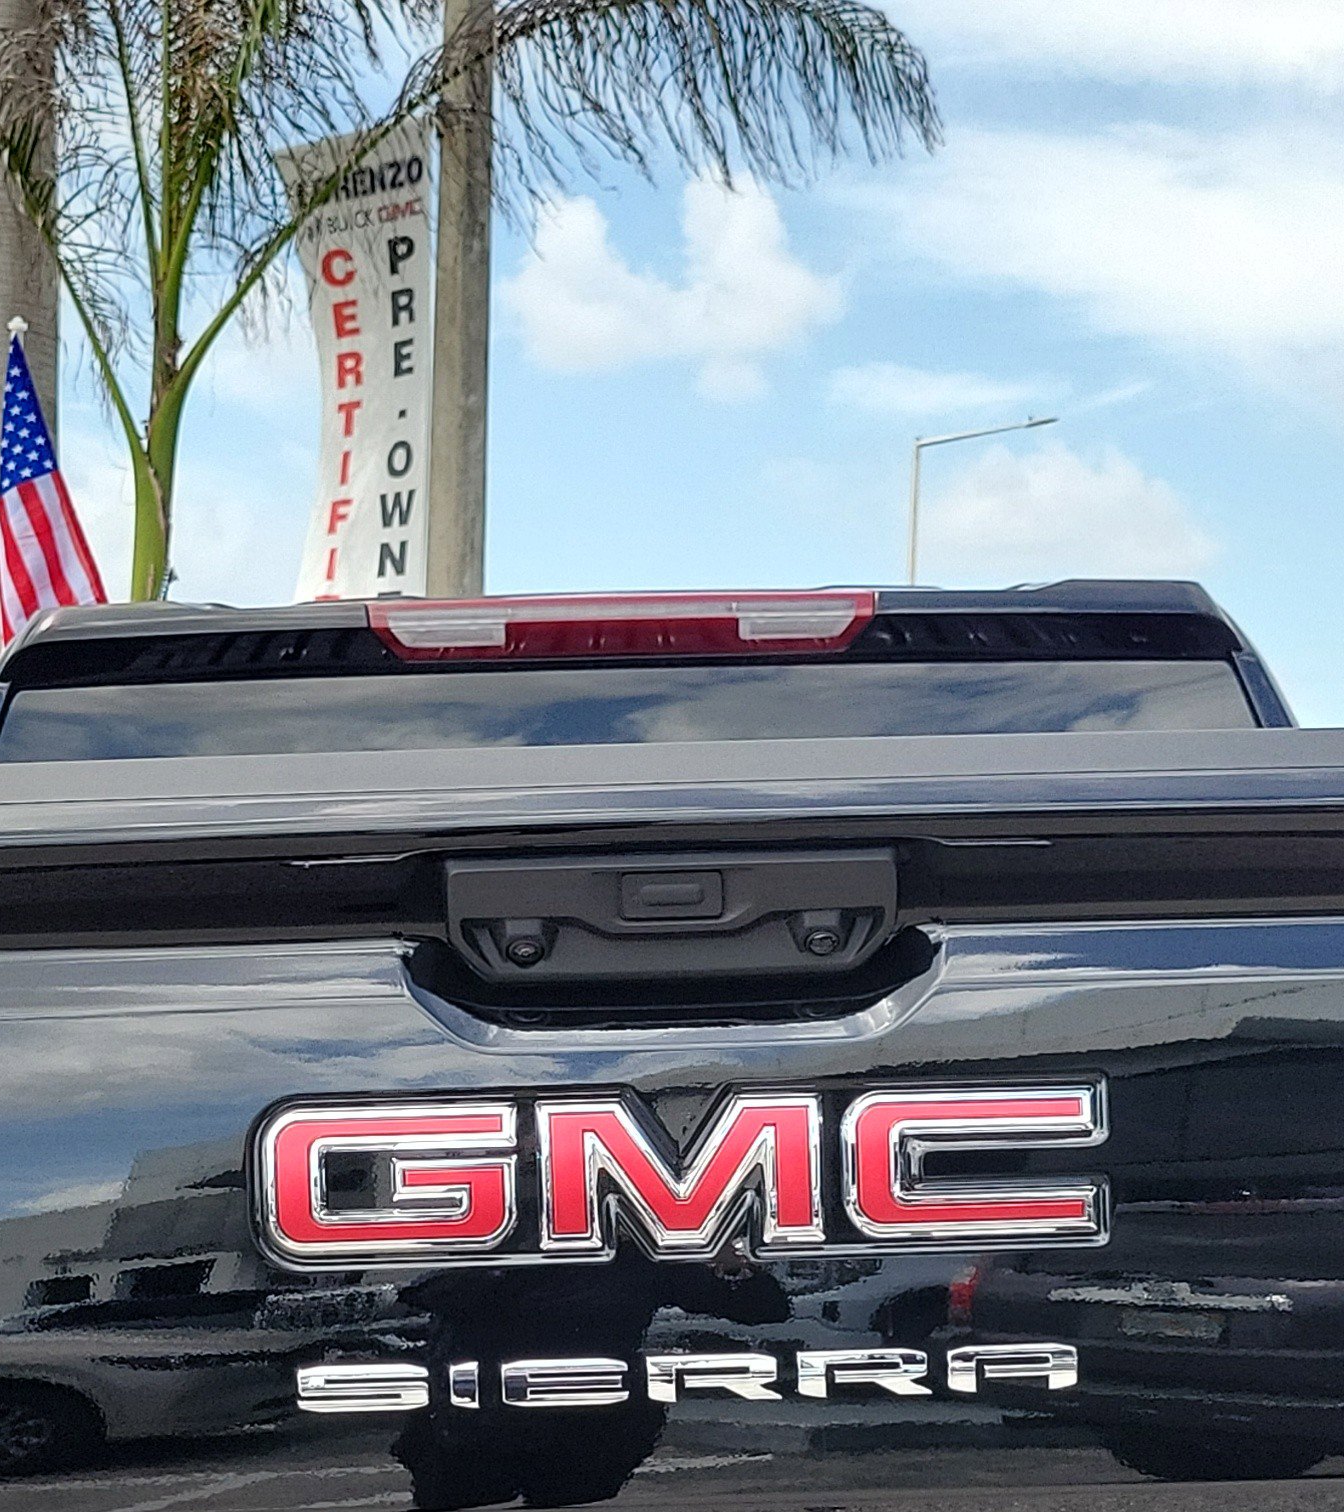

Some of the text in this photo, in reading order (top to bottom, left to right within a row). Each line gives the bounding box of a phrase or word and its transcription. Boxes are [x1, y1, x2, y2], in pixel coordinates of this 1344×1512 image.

[315, 248, 362, 600] CERTIFI
[257, 1081, 1110, 1268] GMC
[296, 1341, 1078, 1413] SIERRA
